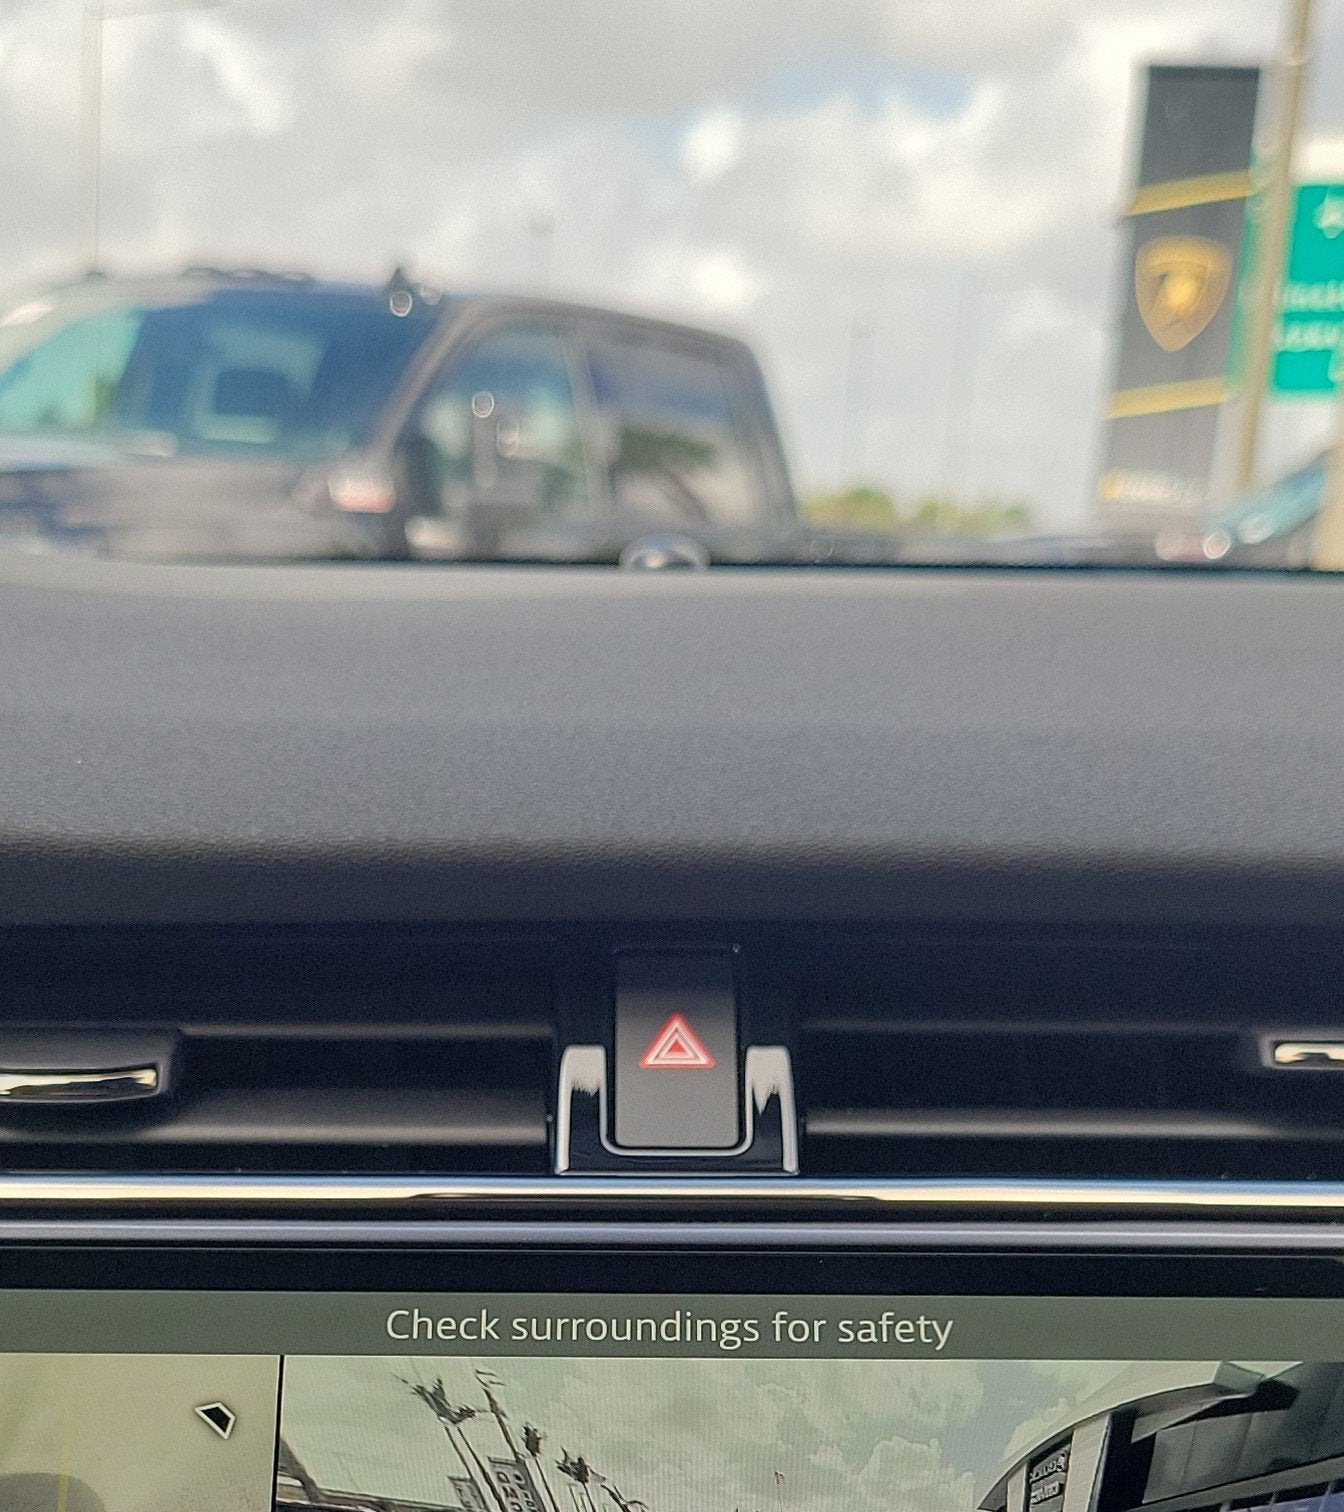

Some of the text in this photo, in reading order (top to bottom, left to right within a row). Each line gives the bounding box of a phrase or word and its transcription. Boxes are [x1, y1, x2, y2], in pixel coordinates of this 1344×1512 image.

[386, 1309, 954, 1350] Check surroundings for safety
